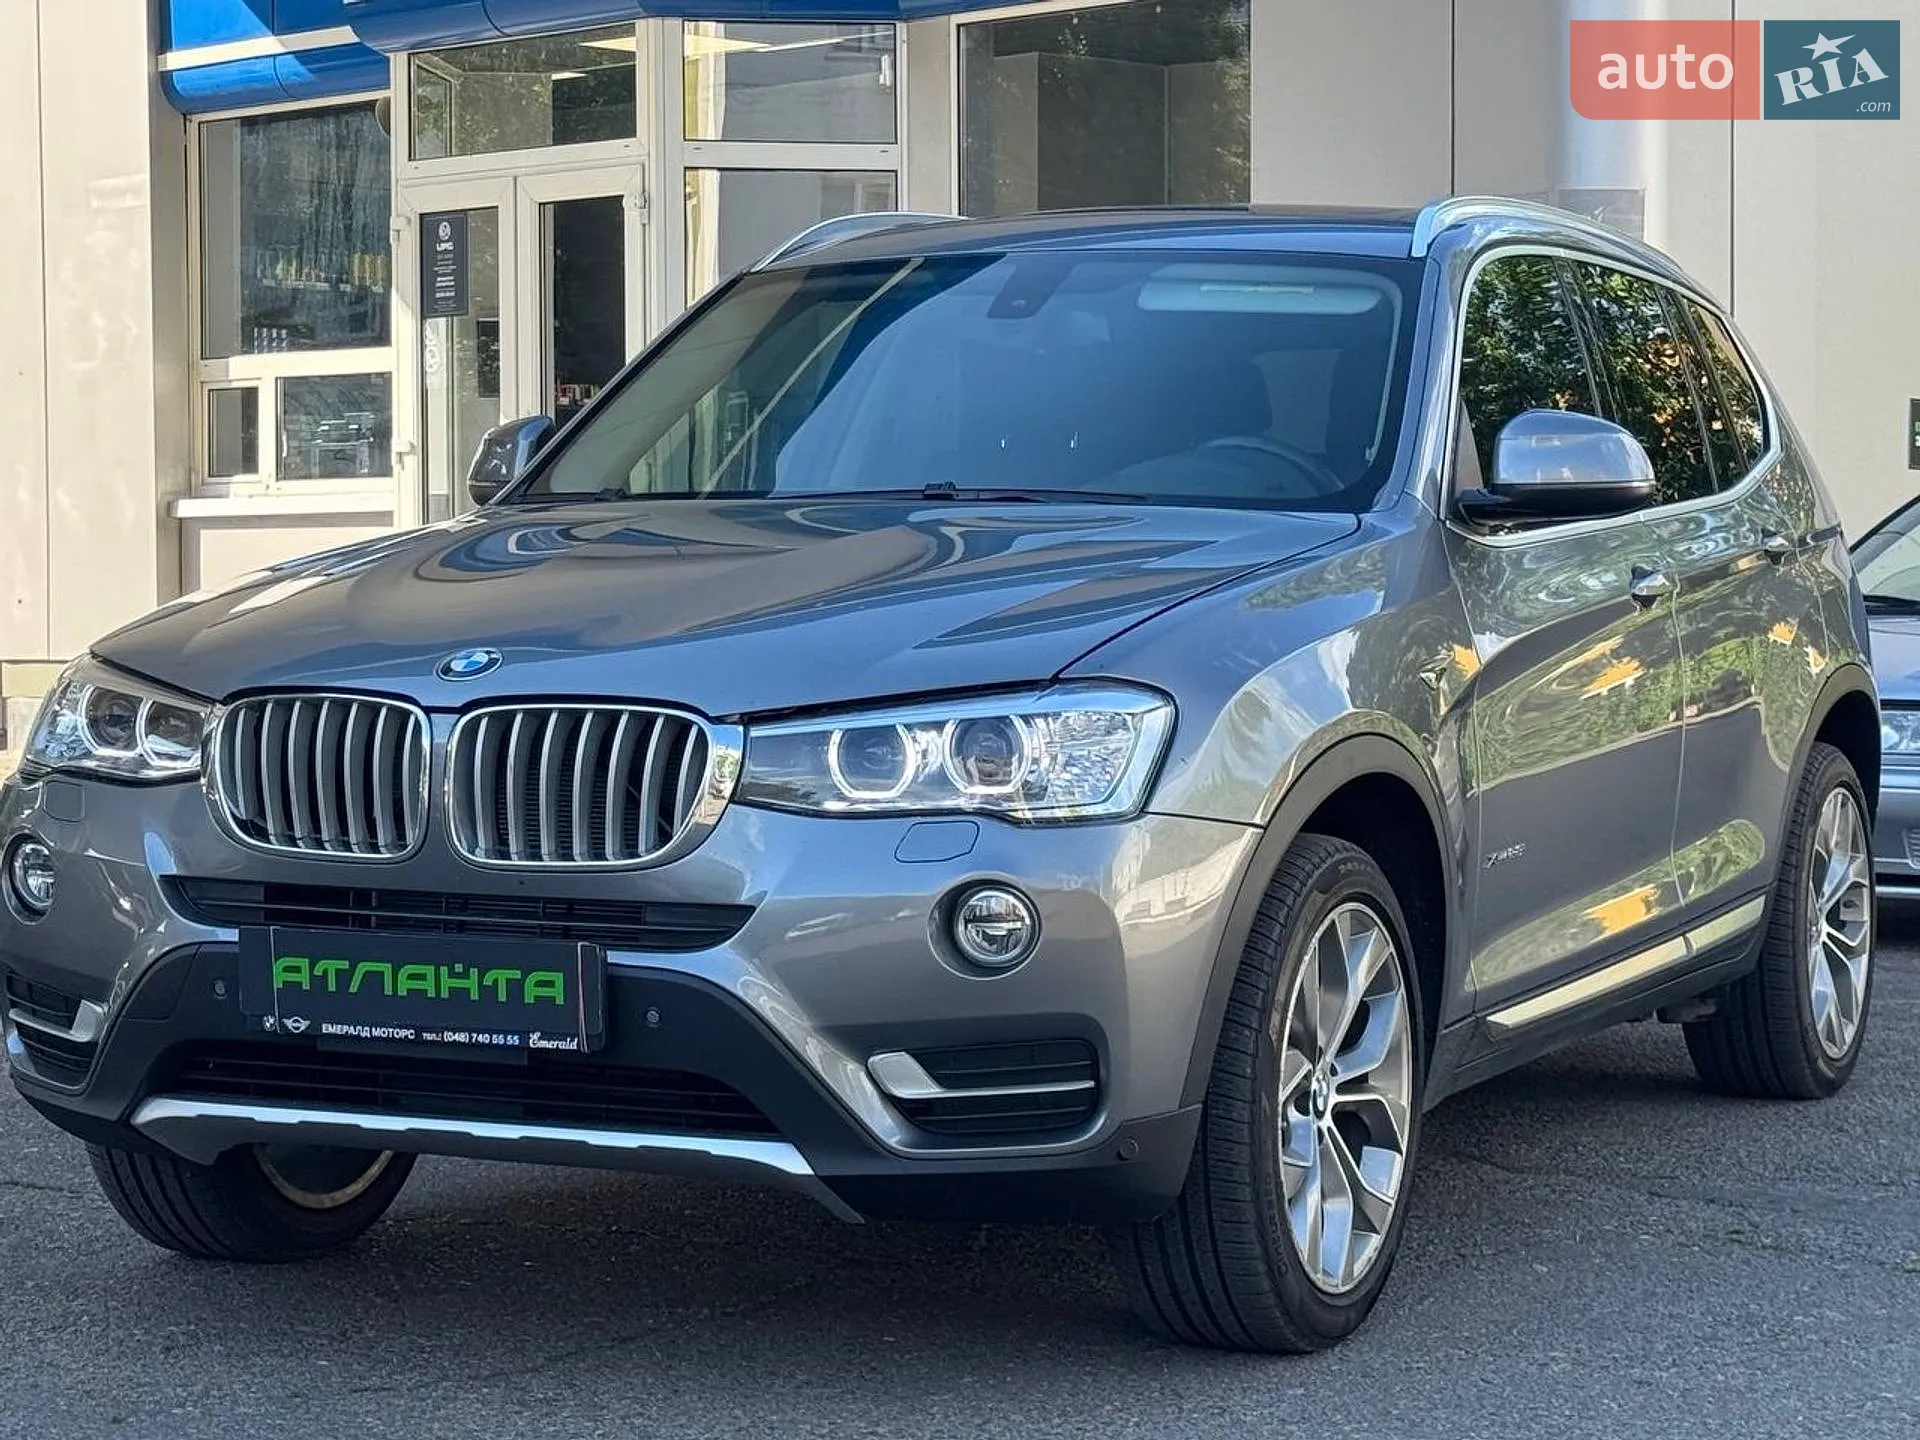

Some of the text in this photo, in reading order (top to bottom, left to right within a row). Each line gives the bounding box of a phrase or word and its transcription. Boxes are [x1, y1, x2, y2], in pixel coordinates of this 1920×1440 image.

[321, 1023, 371, 1038] ЕМЕРАЛД
[371, 1028, 415, 1040] МОТОРС
[443, 1030, 470, 1043] (048)
[471, 1032, 490, 1044] 740
[506, 1034, 520, 1046] 55
[529, 1031, 578, 1050] Emerald
